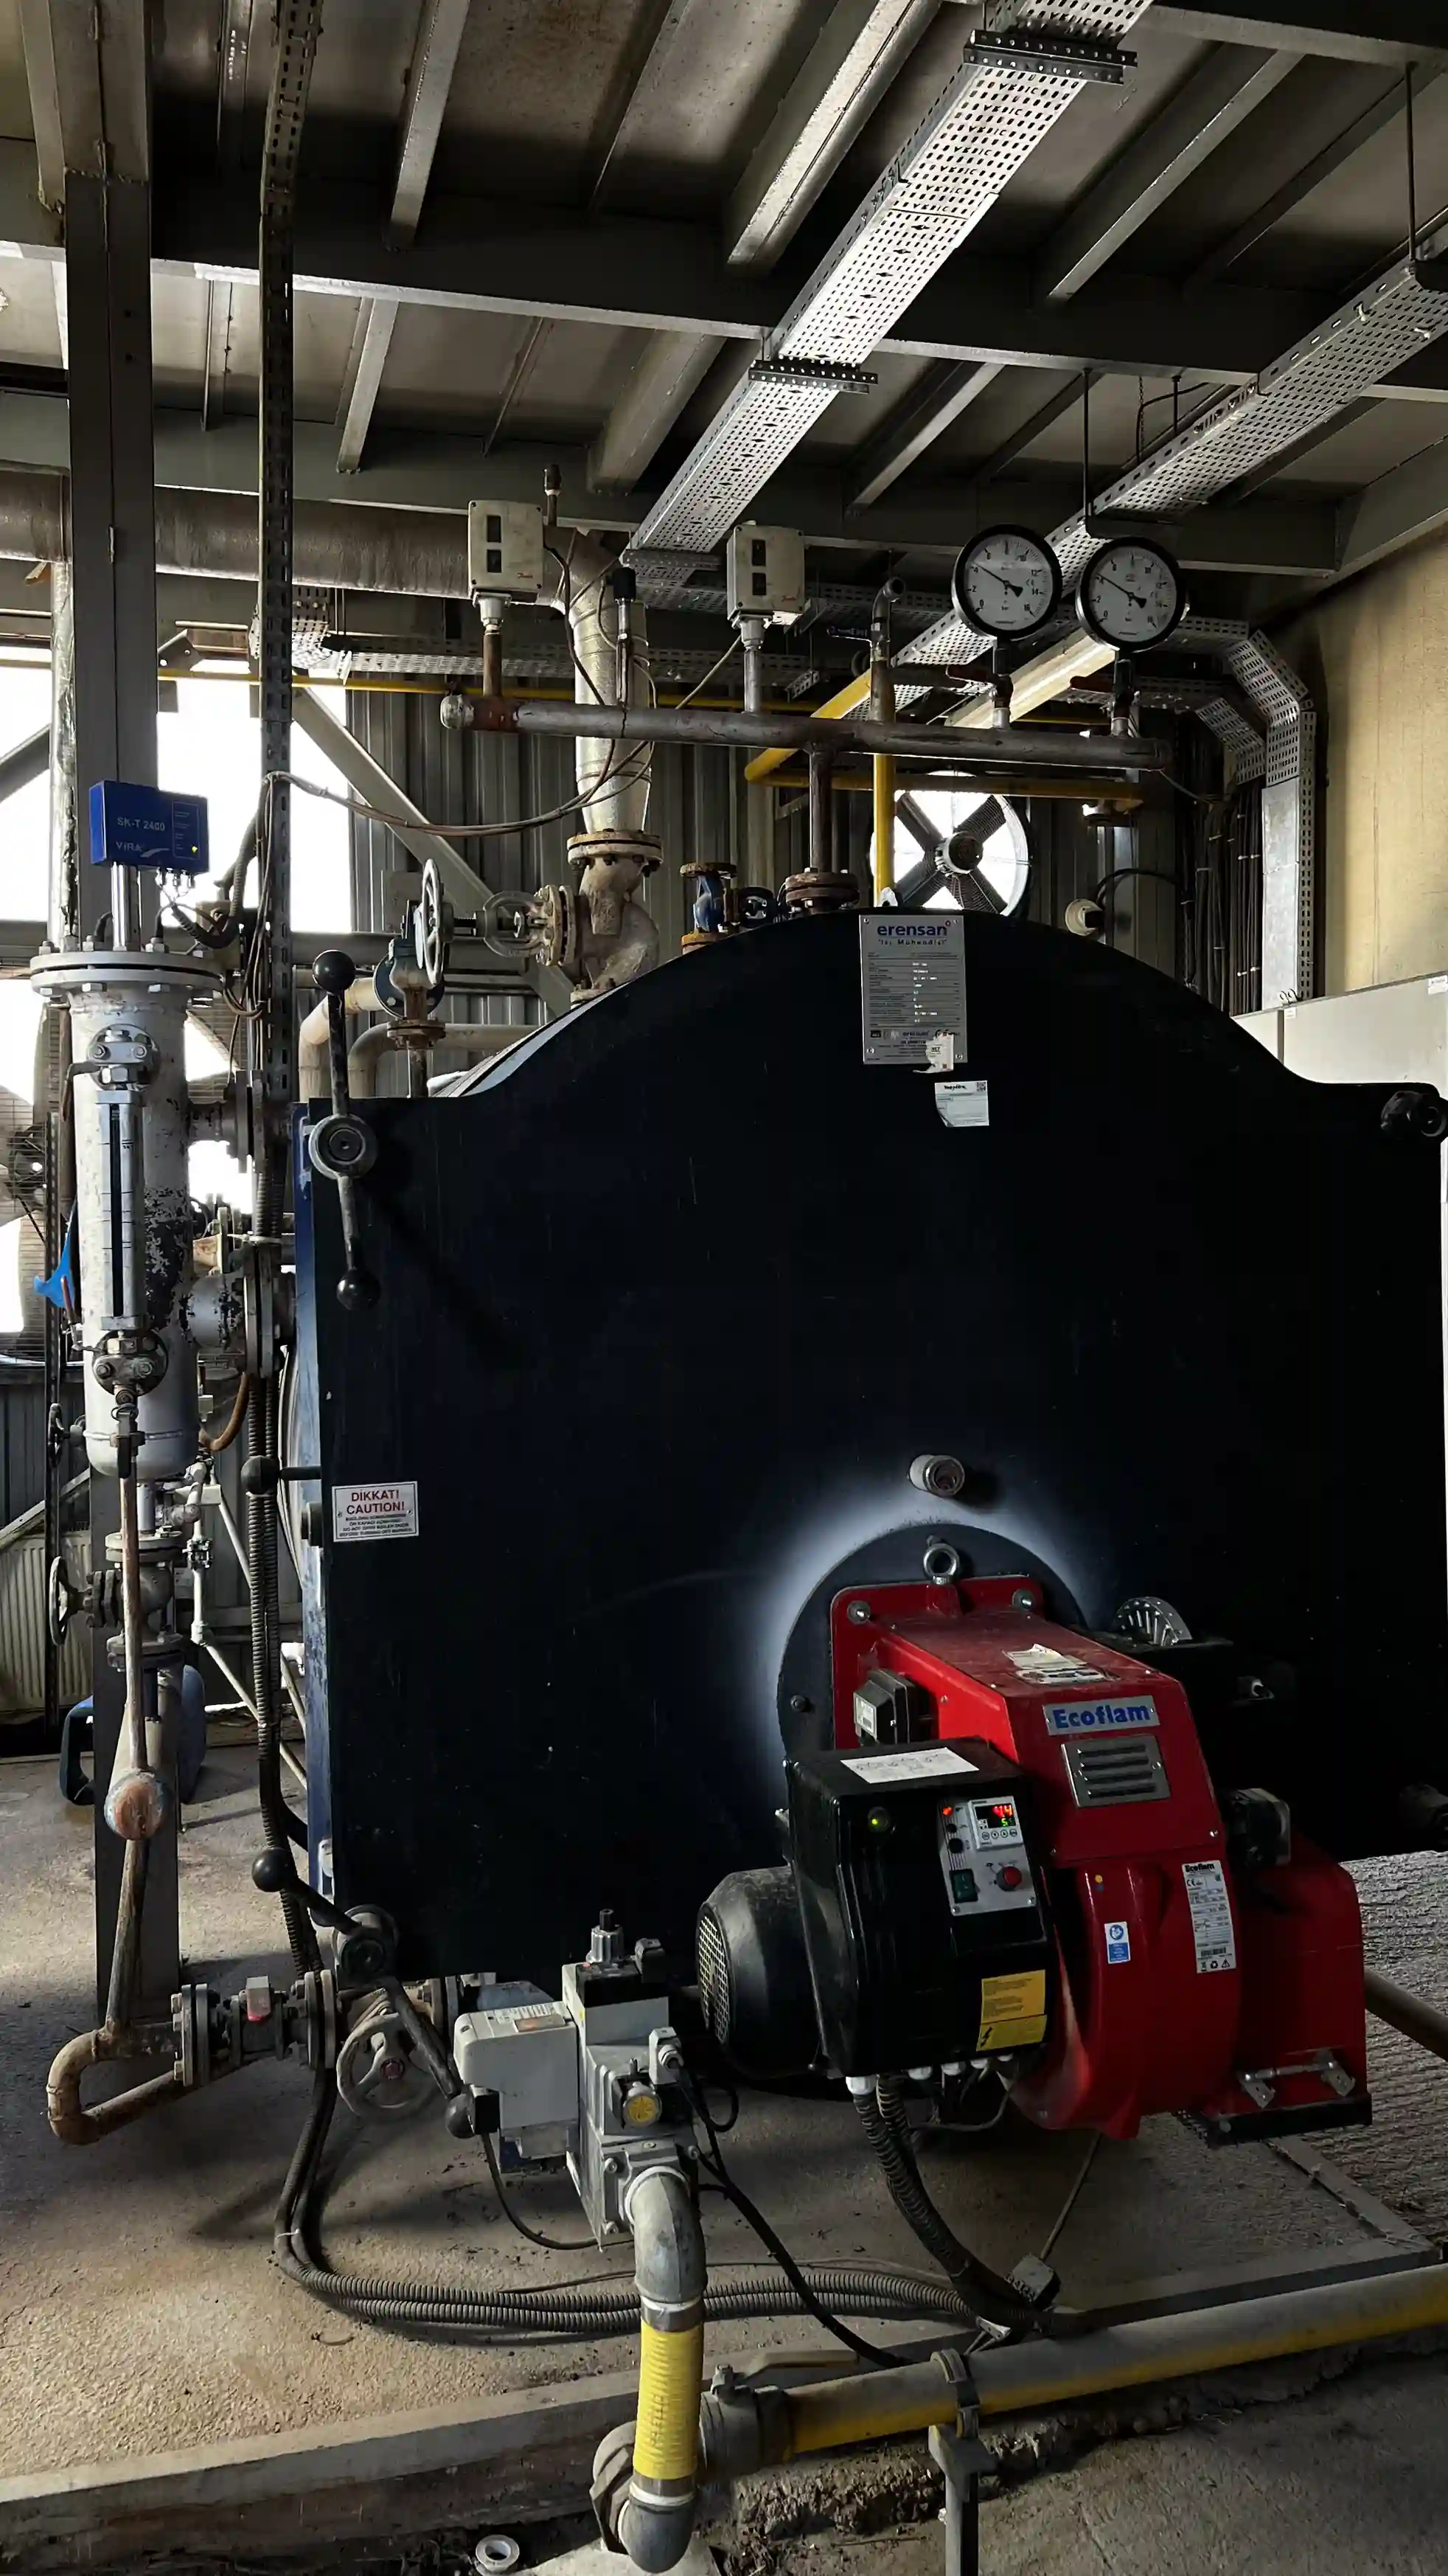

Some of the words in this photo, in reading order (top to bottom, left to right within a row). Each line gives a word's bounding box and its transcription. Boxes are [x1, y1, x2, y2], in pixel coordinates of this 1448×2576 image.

[877, 925, 947, 936] erensan
[347, 1501, 404, 1514] CAUTION!
[1053, 1704, 1150, 1729] Ecoflam
